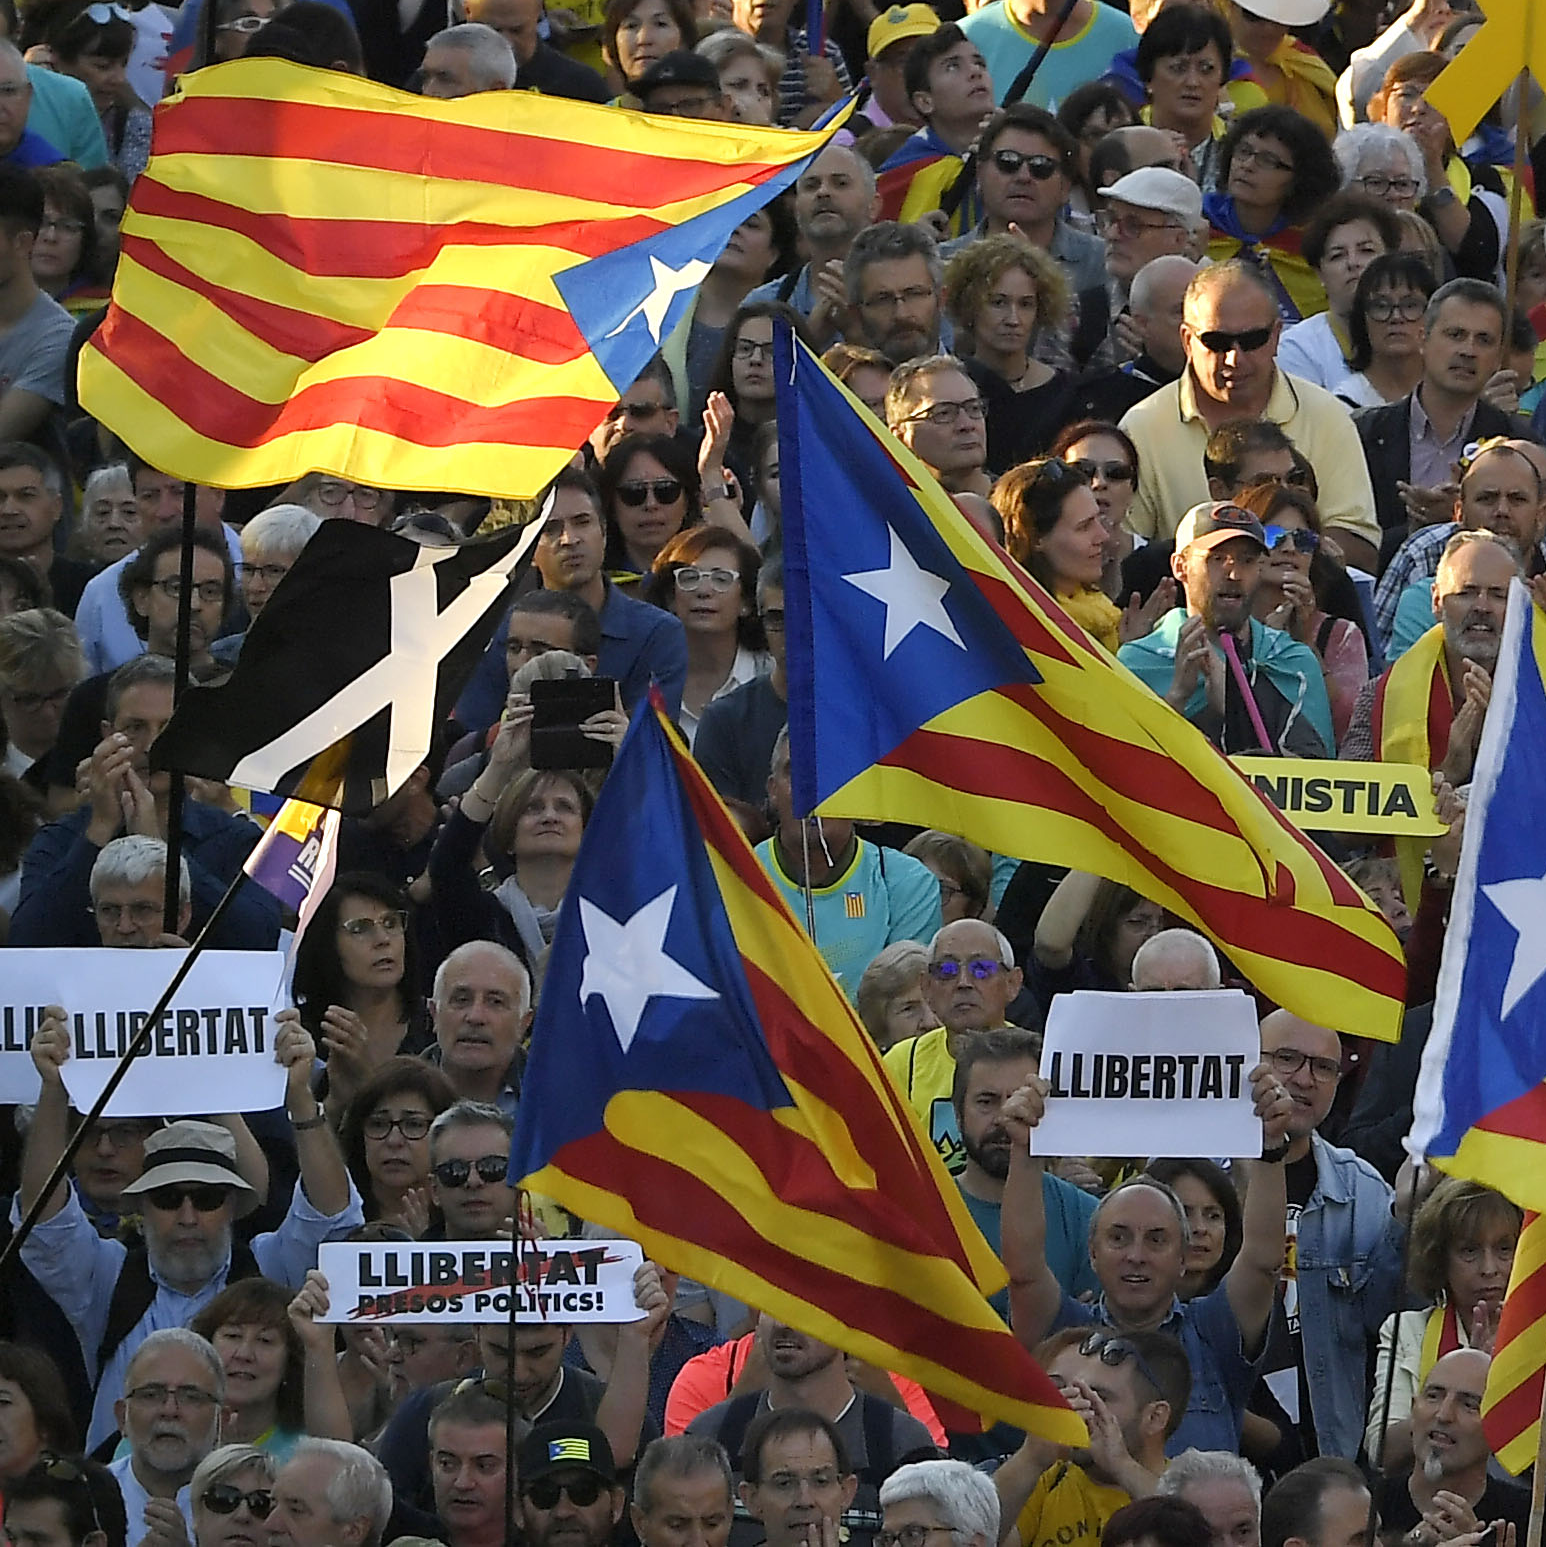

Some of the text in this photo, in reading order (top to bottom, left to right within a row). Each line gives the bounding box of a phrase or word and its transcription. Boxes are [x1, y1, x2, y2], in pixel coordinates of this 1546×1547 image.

[1247, 774, 1420, 819] NISTIA
[1050, 1051, 1246, 1100] LLIBERTAT
[357, 1250, 602, 1288] LLIBERTAT
[357, 1293, 465, 1315] PRESOS
